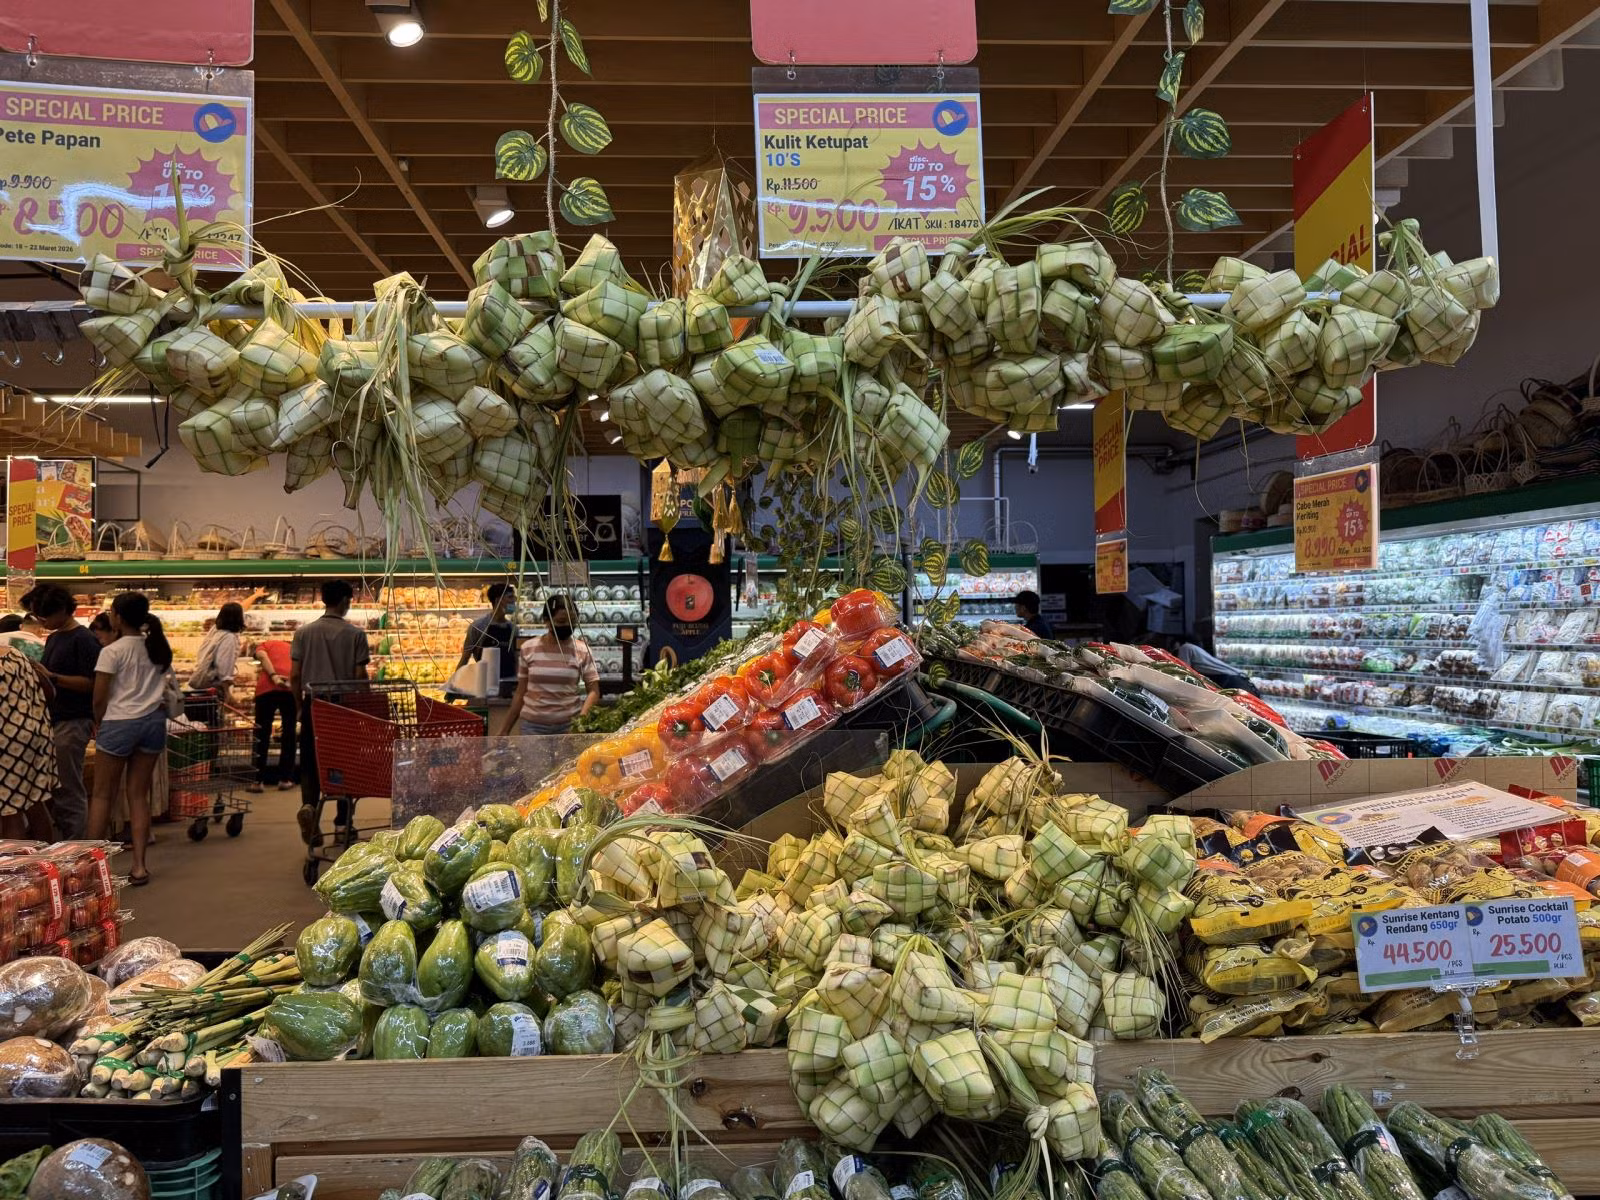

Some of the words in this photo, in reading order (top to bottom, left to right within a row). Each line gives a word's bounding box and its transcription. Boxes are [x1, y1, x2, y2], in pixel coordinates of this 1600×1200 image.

[6, 97, 96, 121] SPECIAL
[102, 103, 164, 125] PRICE
[774, 107, 850, 125] SPECIAL
[855, 107, 907, 124] PRICE
[41, 130, 101, 150] Papan
[764, 134, 802, 149] Kulit
[805, 135, 869, 152] Ketupat
[766, 153, 801, 167] 10'S
[908, 163, 926, 172] UP
[928, 162, 944, 171] TO
[910, 155, 929, 163] disc.
[0, 174, 52, 191] p.9.900
[185, 169, 204, 180] TO
[903, 175, 956, 201] 15%
[788, 198, 881, 235] 9.500
[949, 219, 979, 229] 18478
[194, 250, 219, 260] RICE
[1094, 419, 1123, 458] SPECIAL
[1098, 438, 1120, 472] PRICE
[1299, 481, 1327, 495] SPECIAL
[1327, 478, 1347, 490] PRICE
[9, 501, 36, 516] SPECIAL
[1312, 497, 1330, 508] Merah
[12, 515, 32, 528] PRICE
[1304, 536, 1336, 558] 8.990
[1382, 913, 1419, 925] Sunrise
[1420, 909, 1460, 922] Kentang
[1488, 904, 1527, 916] Sunrise
[1529, 902, 1569, 913] Cocktail
[1385, 922, 1428, 935] Rendang
[1430, 919, 1459, 932] 650gr
[1497, 914, 1531, 925] Potato
[1532, 914, 1562, 925] 500gr
[1383, 939, 1453, 966] 44.500
[1489, 932, 1562, 957] 25.500
